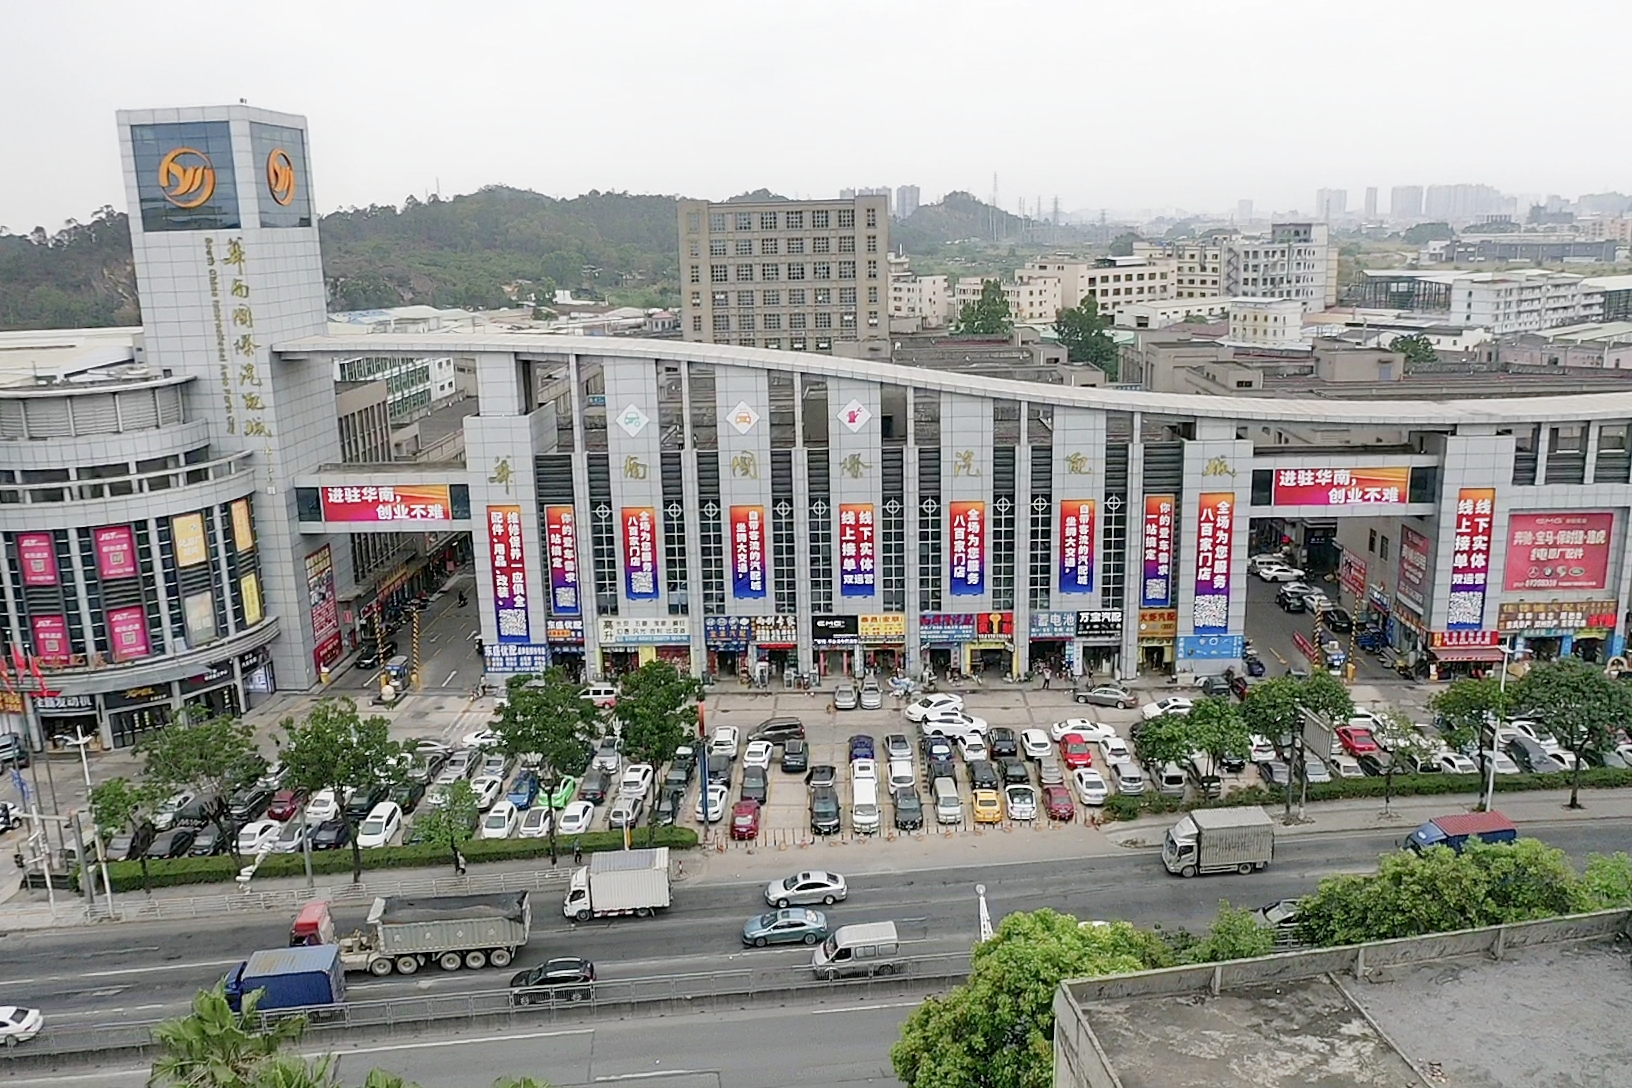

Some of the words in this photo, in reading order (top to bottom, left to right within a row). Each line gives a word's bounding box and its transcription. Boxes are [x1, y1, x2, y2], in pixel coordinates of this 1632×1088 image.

[376, 505, 444, 520] 创业不难
[1328, 487, 1400, 504] 创业不难
[506, 511, 526, 608] 维修保养一应俱全
[549, 523, 564, 568] 一站搞定
[560, 512, 576, 583] 你的爱车需求
[626, 516, 641, 567] 八百家门店
[638, 510, 653, 572] 全场为您服务
[748, 510, 762, 591] 自带客流的汽配城
[840, 510, 857, 572] 线上接单
[858, 510, 874, 572] 线下实体
[953, 515, 966, 578] 八百家门店
[966, 508, 980, 585] 全场为您服务
[1076, 504, 1090, 586] 自带客流的汽配城
[1144, 513, 1158, 562] 一站搞定
[1158, 502, 1171, 576] 你的爱车需求
[1198, 508, 1214, 582] 八百家门店
[1213, 500, 1232, 590] 全场为您服务
[1452, 500, 1474, 568] 线上接单
[1470, 498, 1492, 568] 线下实体
[842, 574, 874, 586] 双运营
[1452, 573, 1486, 585] 双运营
[1037, 613, 1076, 626] 蓄电池
